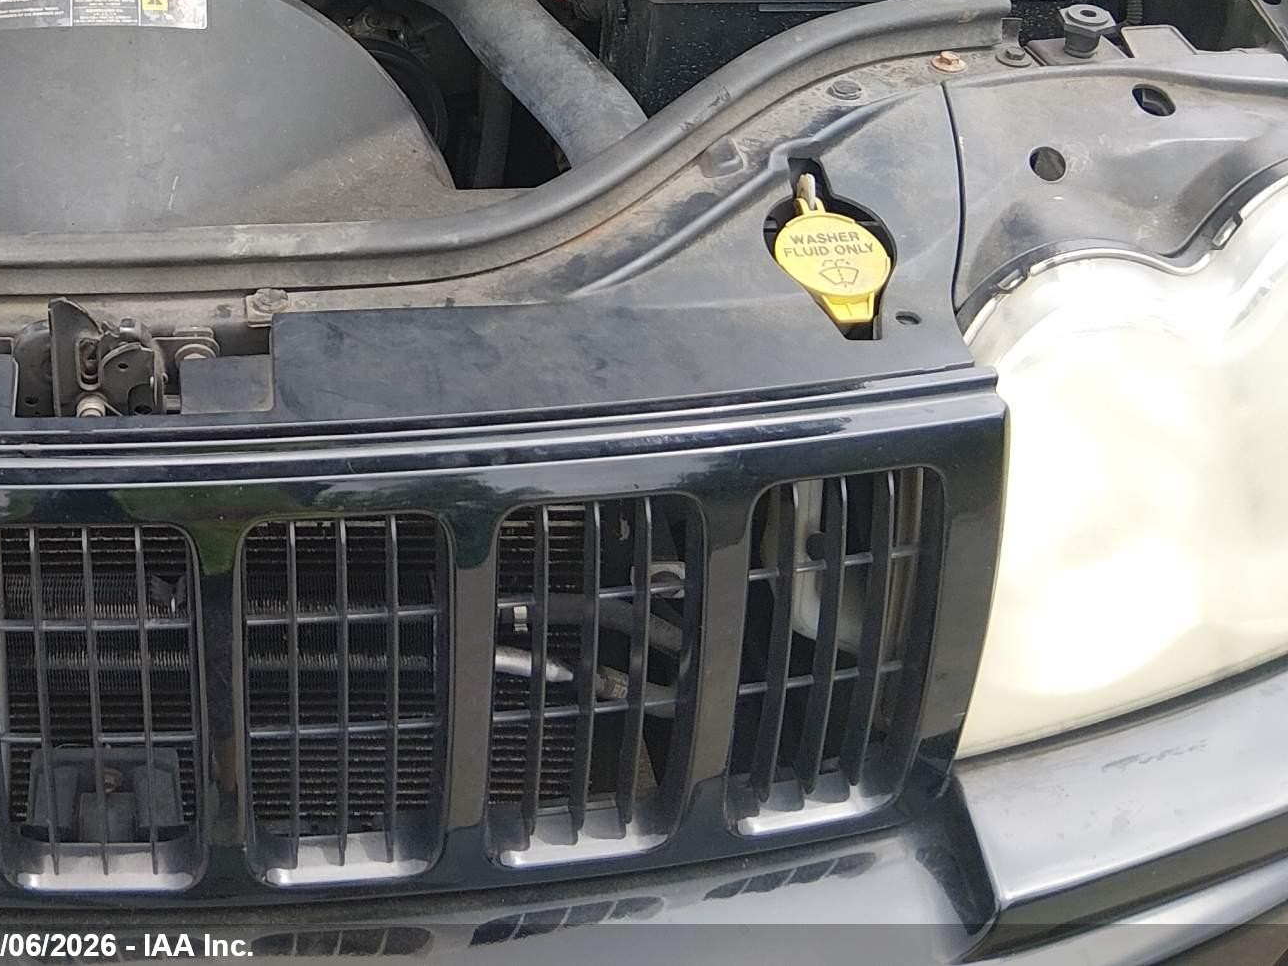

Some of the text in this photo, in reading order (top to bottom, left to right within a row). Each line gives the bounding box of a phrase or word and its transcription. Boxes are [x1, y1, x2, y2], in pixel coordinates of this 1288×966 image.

[790, 231, 860, 245] WASHER
[784, 242, 874, 257] FLUID ONLY
